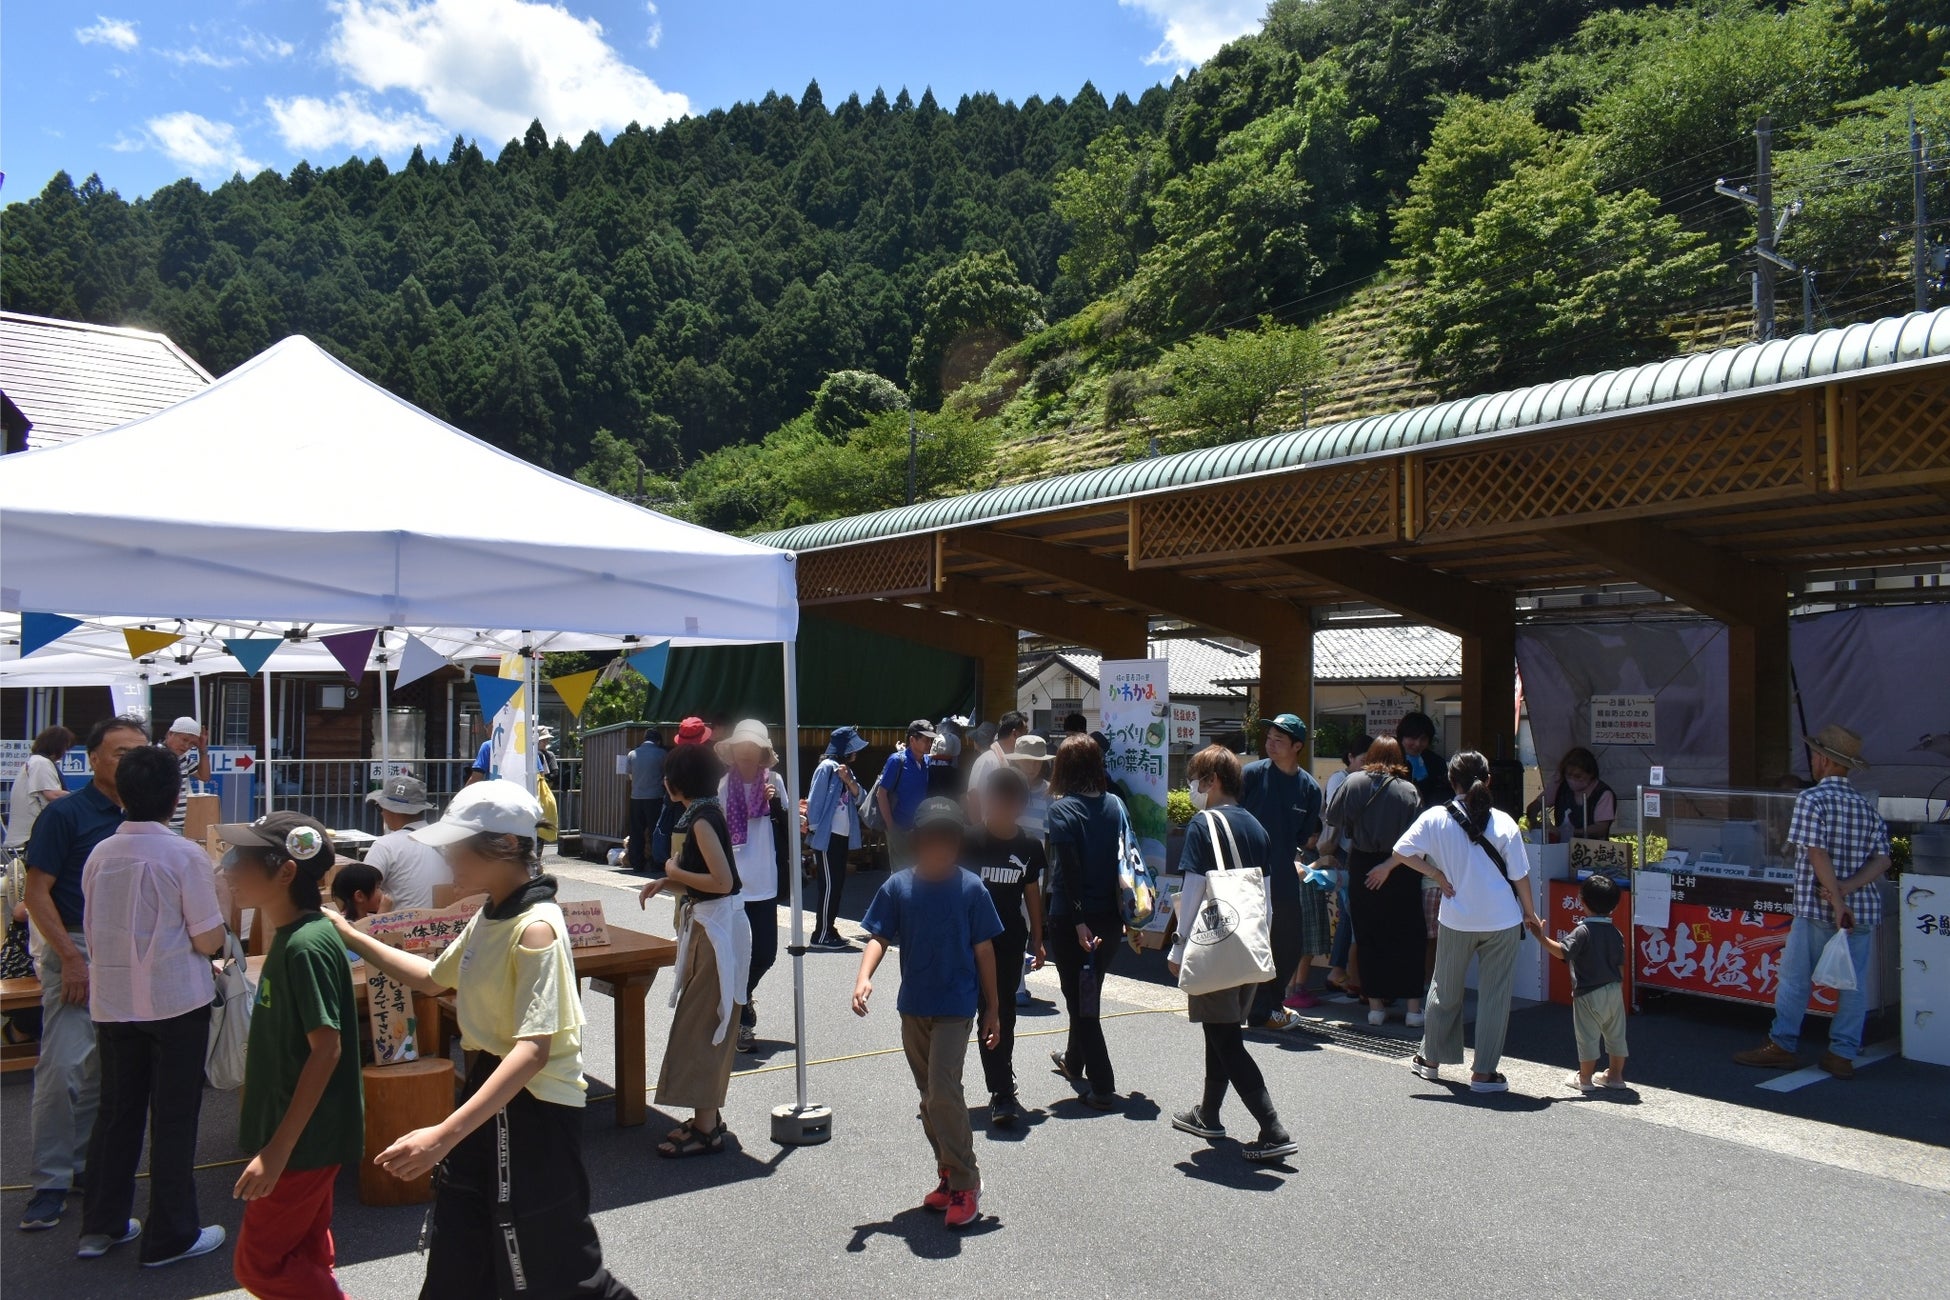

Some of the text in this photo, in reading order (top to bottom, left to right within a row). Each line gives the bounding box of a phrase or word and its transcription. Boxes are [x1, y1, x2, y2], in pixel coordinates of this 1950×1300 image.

[1109, 684, 1155, 701] かわかみ
[1609, 698, 1636, 706] お願い
[1104, 723, 1144, 743] 手づくり
[4, 742, 31, 750] お願い
[930, 803, 951, 811] FILA
[1571, 842, 1627, 868] 鮎塩焼き
[981, 866, 1022, 884] PUMA
